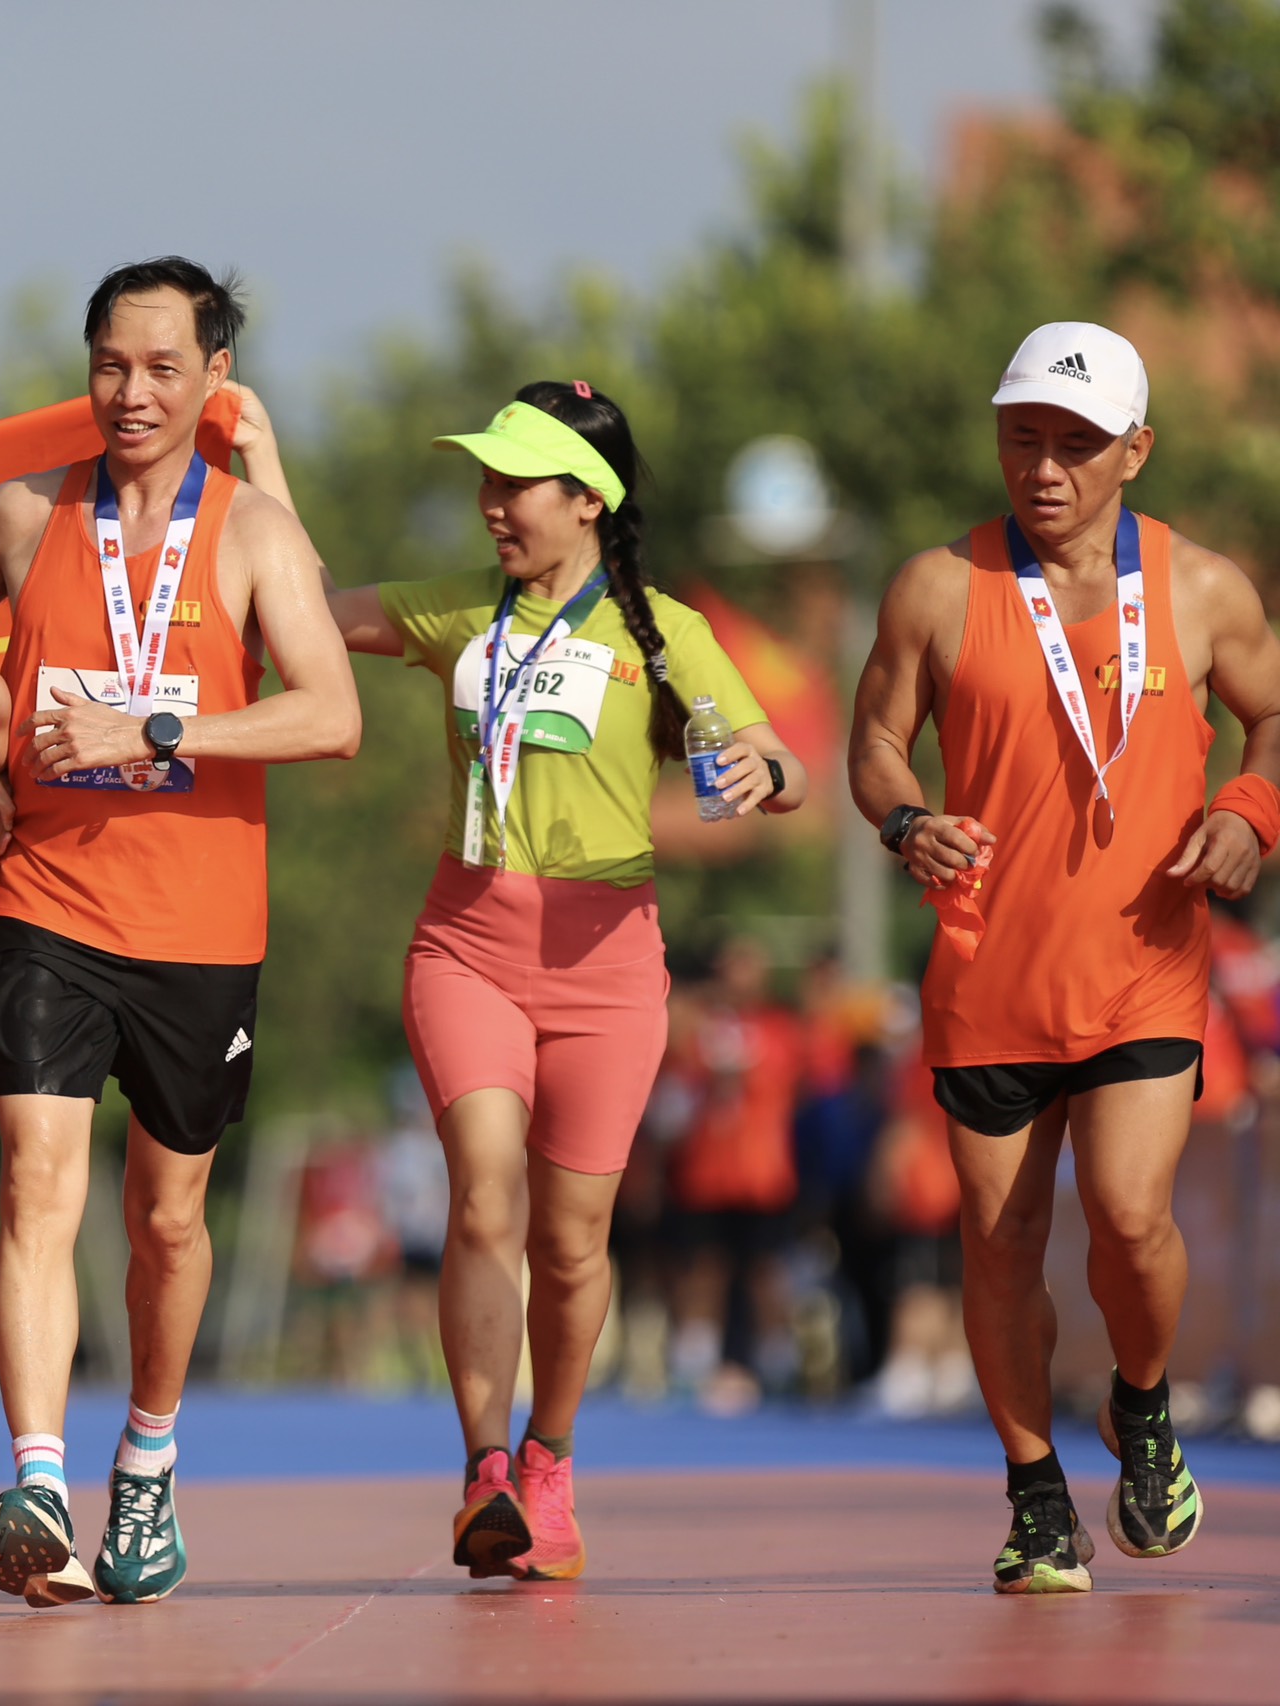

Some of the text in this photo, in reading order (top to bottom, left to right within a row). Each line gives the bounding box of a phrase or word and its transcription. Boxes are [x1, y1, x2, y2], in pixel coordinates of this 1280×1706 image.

[1048, 364, 1092, 383] adidas
[111, 585, 126, 615] 10 KM
[155, 584, 171, 613] 10 KM
[575, 650, 592, 661] KM
[1050, 643, 1069, 673] 10 KM
[1128, 642, 1139, 672] 10 KM
[164, 687, 181, 696] KM
[545, 733, 567, 743] MEDAL
